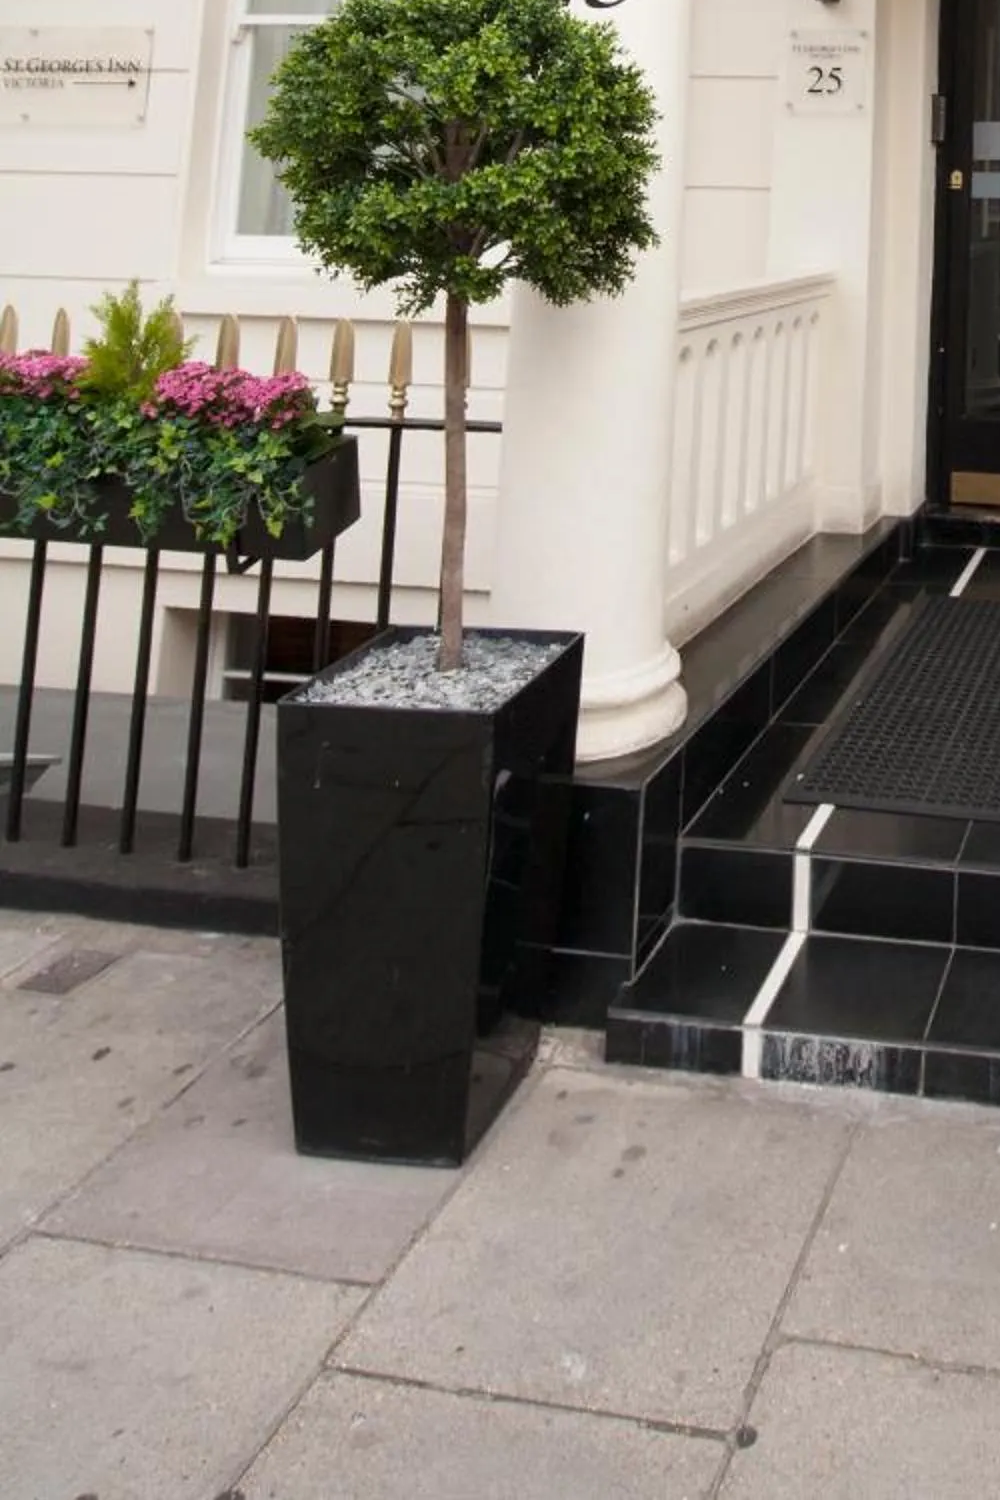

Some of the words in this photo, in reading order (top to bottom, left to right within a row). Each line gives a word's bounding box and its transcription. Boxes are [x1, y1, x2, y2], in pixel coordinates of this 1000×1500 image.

[107, 57, 141, 73] INN
[3, 78, 64, 88] VICTORIA
[806, 65, 843, 94] 25
